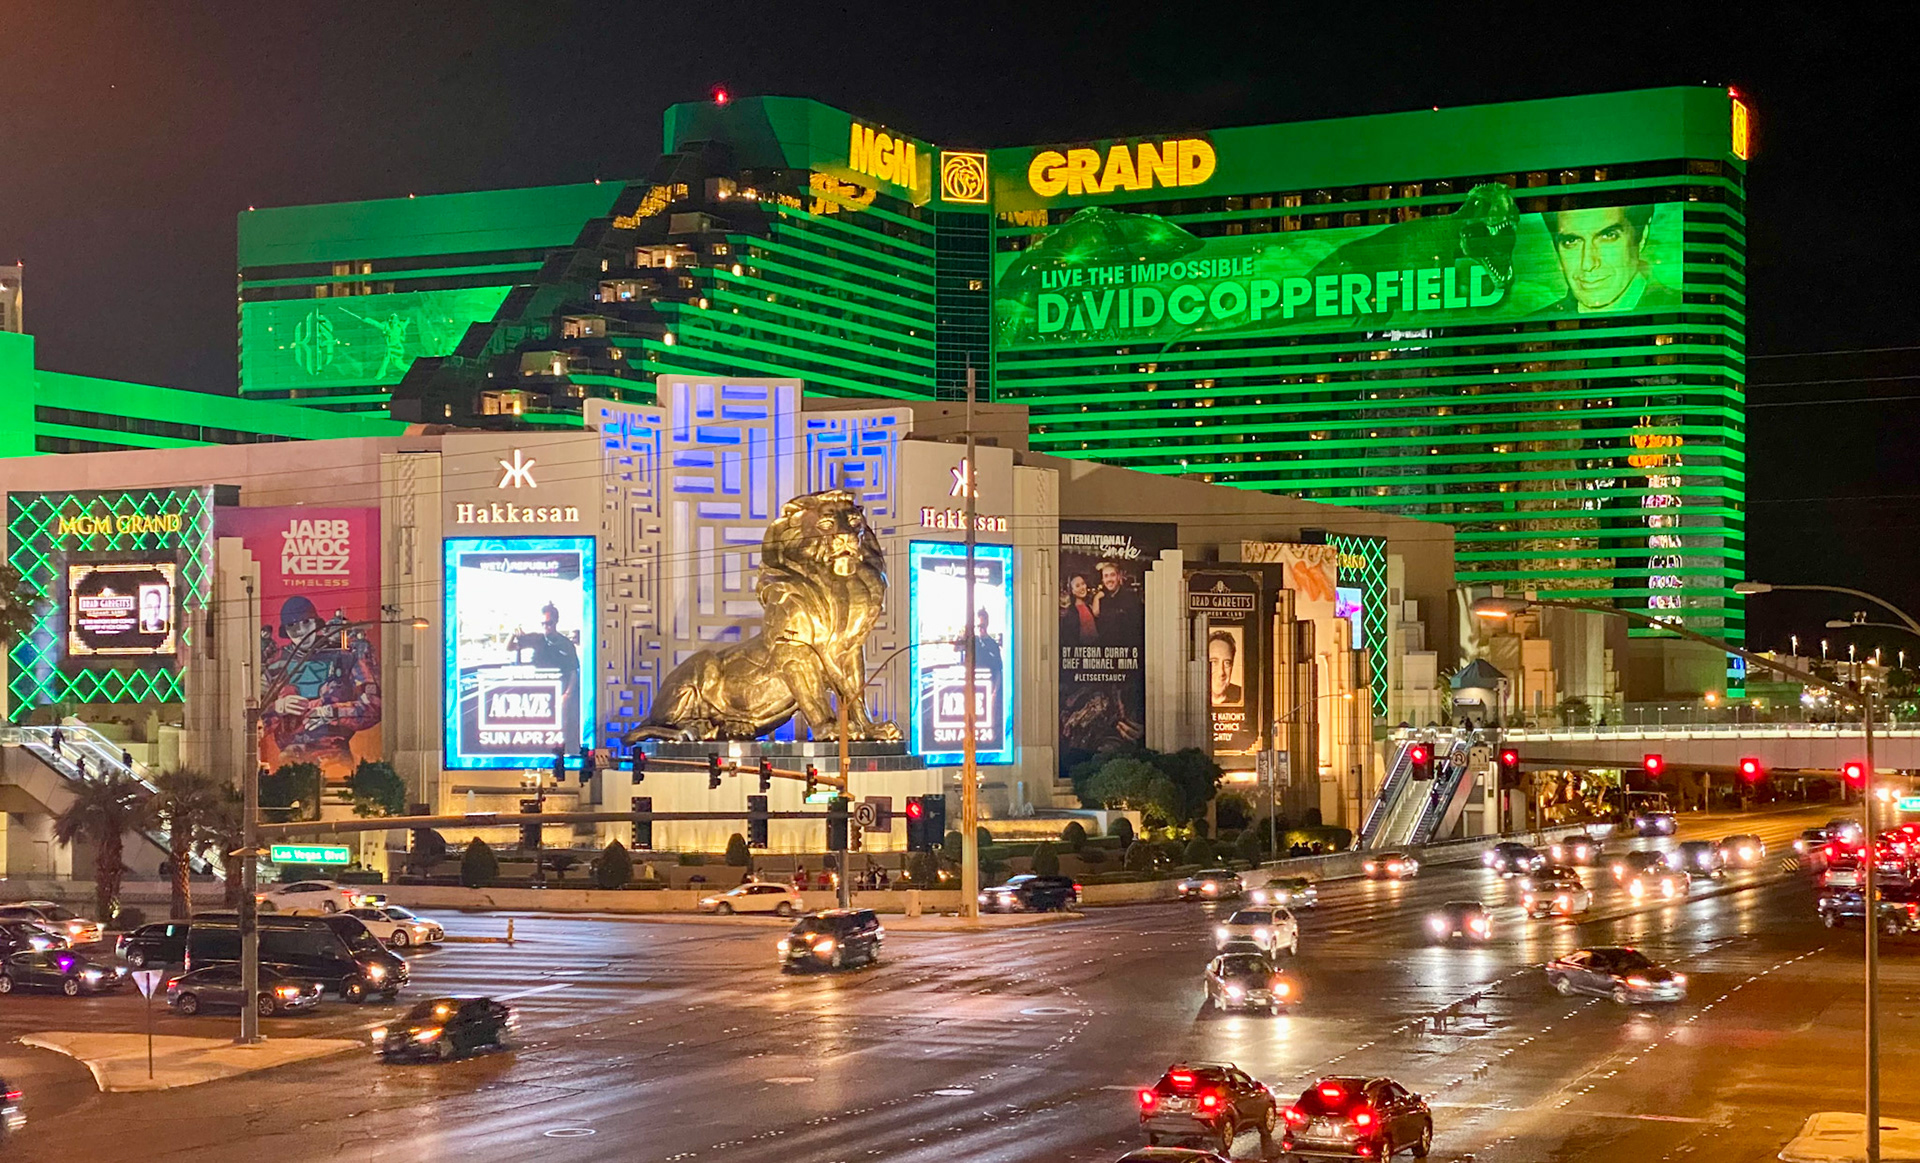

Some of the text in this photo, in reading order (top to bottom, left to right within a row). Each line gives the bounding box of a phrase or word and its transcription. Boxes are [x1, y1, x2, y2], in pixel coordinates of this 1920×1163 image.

[850, 122, 1216, 197] MGM GRAND
[1042, 257, 1253, 289] LIVE THE IMPOSSIBLE
[456, 502, 579, 524] Hakkasan
[58, 514, 182, 535] MGM GRAND
[281, 519, 350, 539] JABB
[1061, 533, 1126, 546] INTERNATIONAL
[281, 538, 350, 556] AWOC
[281, 555, 350, 575] KEEZ
[283, 579, 349, 587] TIMELESS
[1192, 595, 1251, 608] BRAD GARRETT'S
[1062, 647, 1071, 658] BY
[1074, 647, 1102, 658] AYESHA
[1104, 647, 1129, 658] CURRY
[1062, 658, 1138, 670] CHEF MICHAEL MINA
[1074, 673, 1127, 682] #LETSGETSAUCY
[479, 731, 565, 744] SUN APR 24
[934, 728, 956, 742] SUN
[980, 728, 993, 742] 24
[274, 849, 345, 862] Las Vegas Blvd
